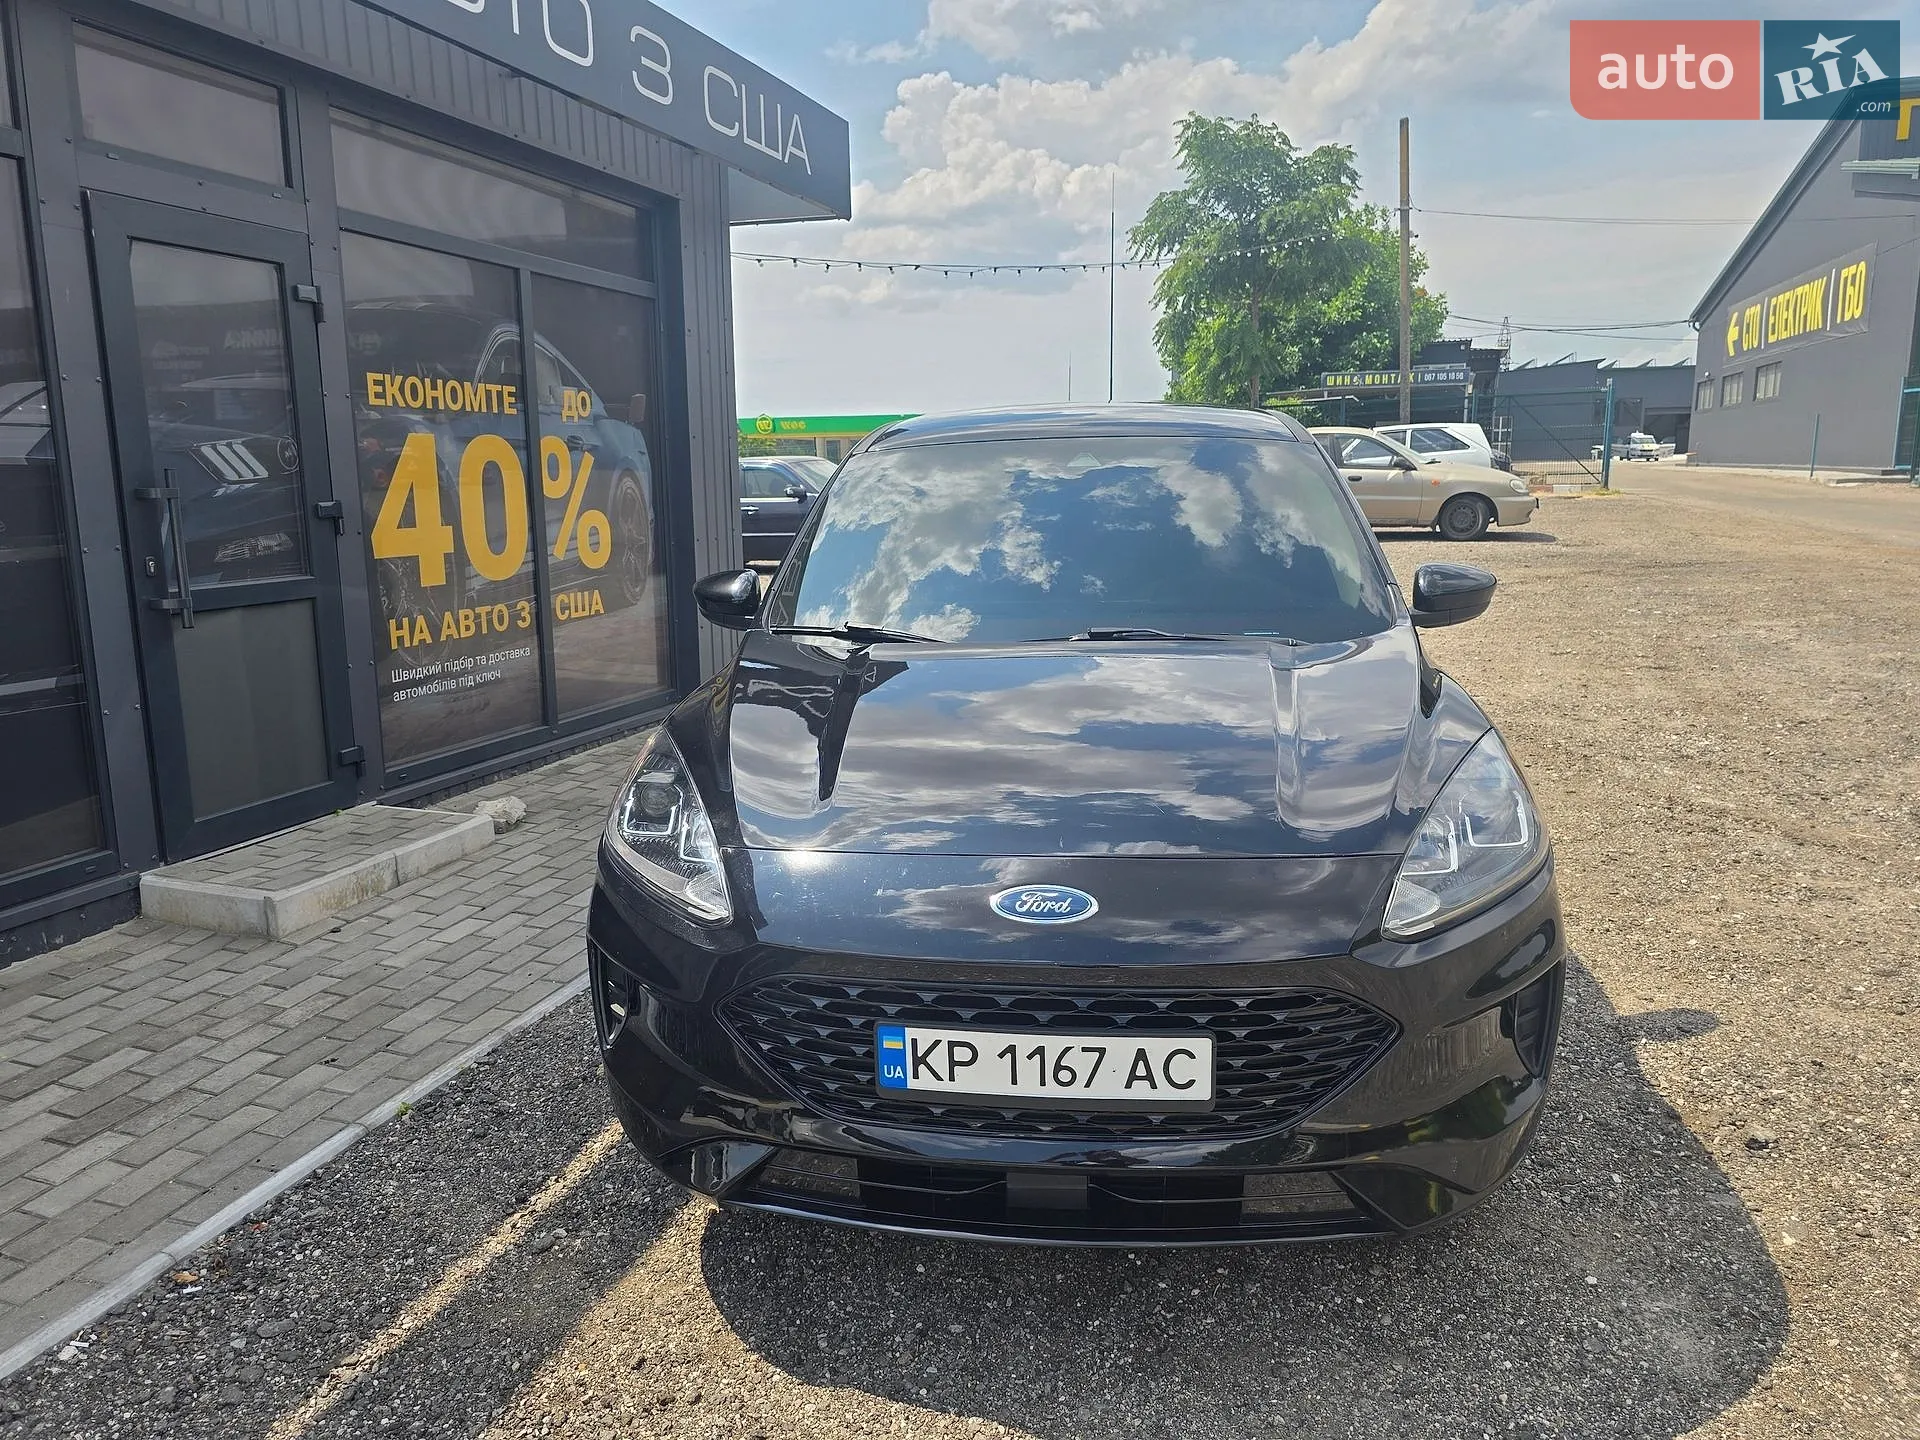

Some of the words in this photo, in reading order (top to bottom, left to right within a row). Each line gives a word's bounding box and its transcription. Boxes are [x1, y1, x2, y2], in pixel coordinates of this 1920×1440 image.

[703, 64, 813, 177] США
[1742, 303, 1761, 352] СТО
[1767, 275, 1828, 344] ЕЛЕКТРИК
[1836, 260, 1867, 324] ГБО
[366, 371, 518, 415] ЕКОНОМТЕ
[560, 389, 592, 423] ДО
[371, 432, 613, 588] 40%
[389, 614, 433, 650] НА
[439, 604, 510, 642] АВТО
[555, 589, 605, 622] США
[391, 661, 443, 683] Швидкий
[444, 657, 474, 674] підбір
[476, 655, 487, 666] та
[488, 646, 531, 665] доставка
[392, 678, 457, 702] автомобілів
[459, 674, 475, 688] під
[476, 668, 501, 684] ключ
[1015, 889, 1073, 915] Ford
[883, 1064, 905, 1080] UA
[910, 1036, 980, 1083] KP
[995, 1043, 1108, 1089] 1167
[1123, 1046, 1197, 1091] AC
